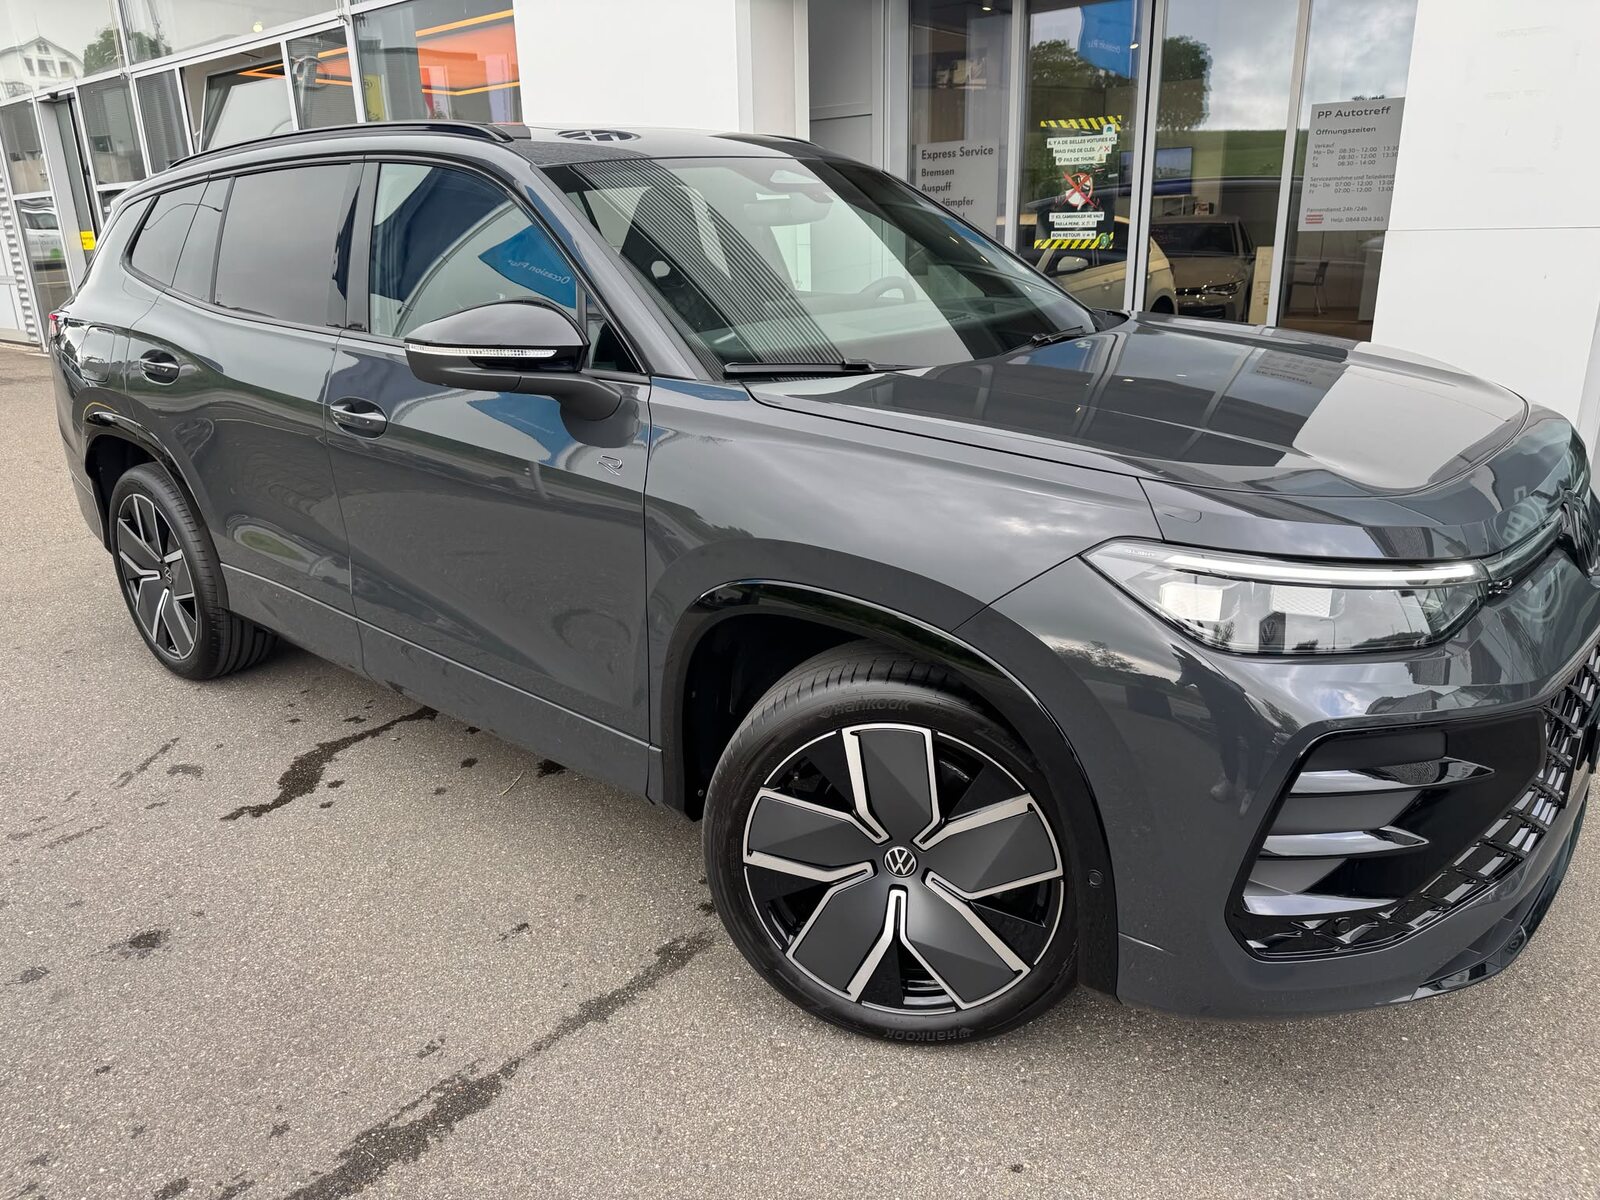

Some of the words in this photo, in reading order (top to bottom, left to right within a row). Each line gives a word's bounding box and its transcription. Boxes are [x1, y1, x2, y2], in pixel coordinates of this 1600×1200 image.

[1318, 110, 1332, 119] PP
[1335, 106, 1391, 118] Autotreff
[1316, 127, 1376, 135] Öffnungszeiten
[921, 150, 956, 161] Express
[959, 146, 994, 157] Service
[921, 168, 954, 177] Bremsen
[921, 182, 952, 193] Auspuff
[941, 196, 974, 208] dämpfer
